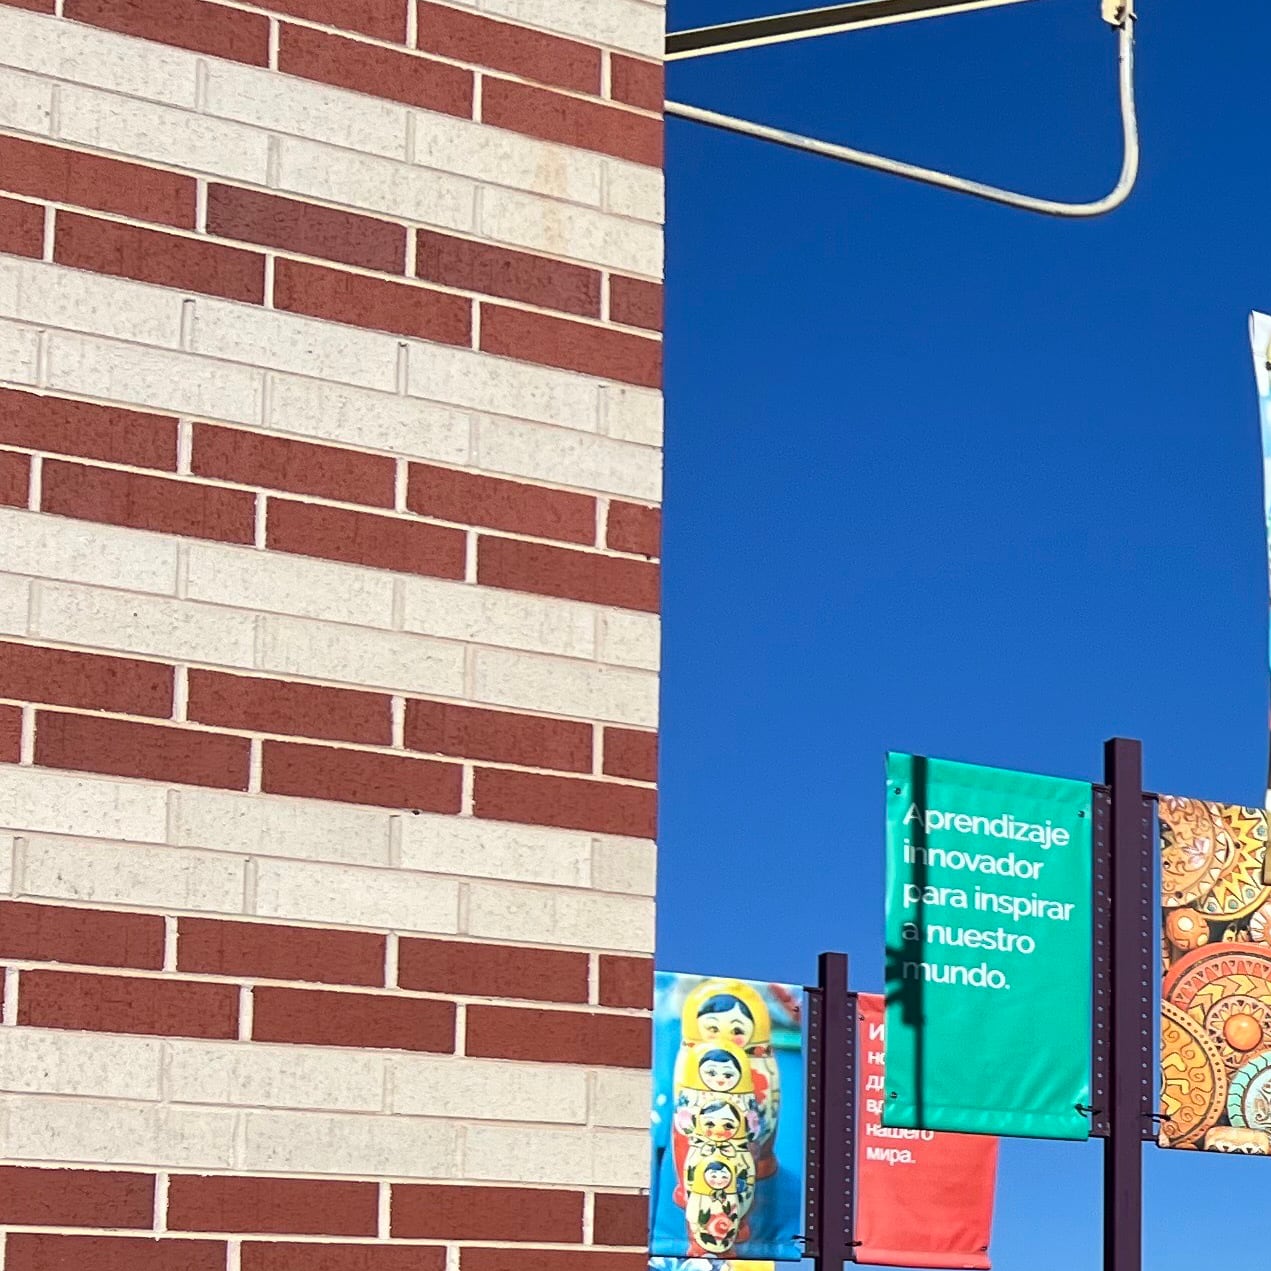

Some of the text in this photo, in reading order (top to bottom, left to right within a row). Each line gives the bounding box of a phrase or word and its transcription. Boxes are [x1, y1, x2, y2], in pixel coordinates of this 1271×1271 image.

[903, 802, 1070, 849] Aprendizaje
[903, 838, 1044, 880] innovador
[903, 883, 1075, 922] para inspirar
[902, 922, 1035, 954] a nuestro
[903, 961, 1010, 990] mundo.
